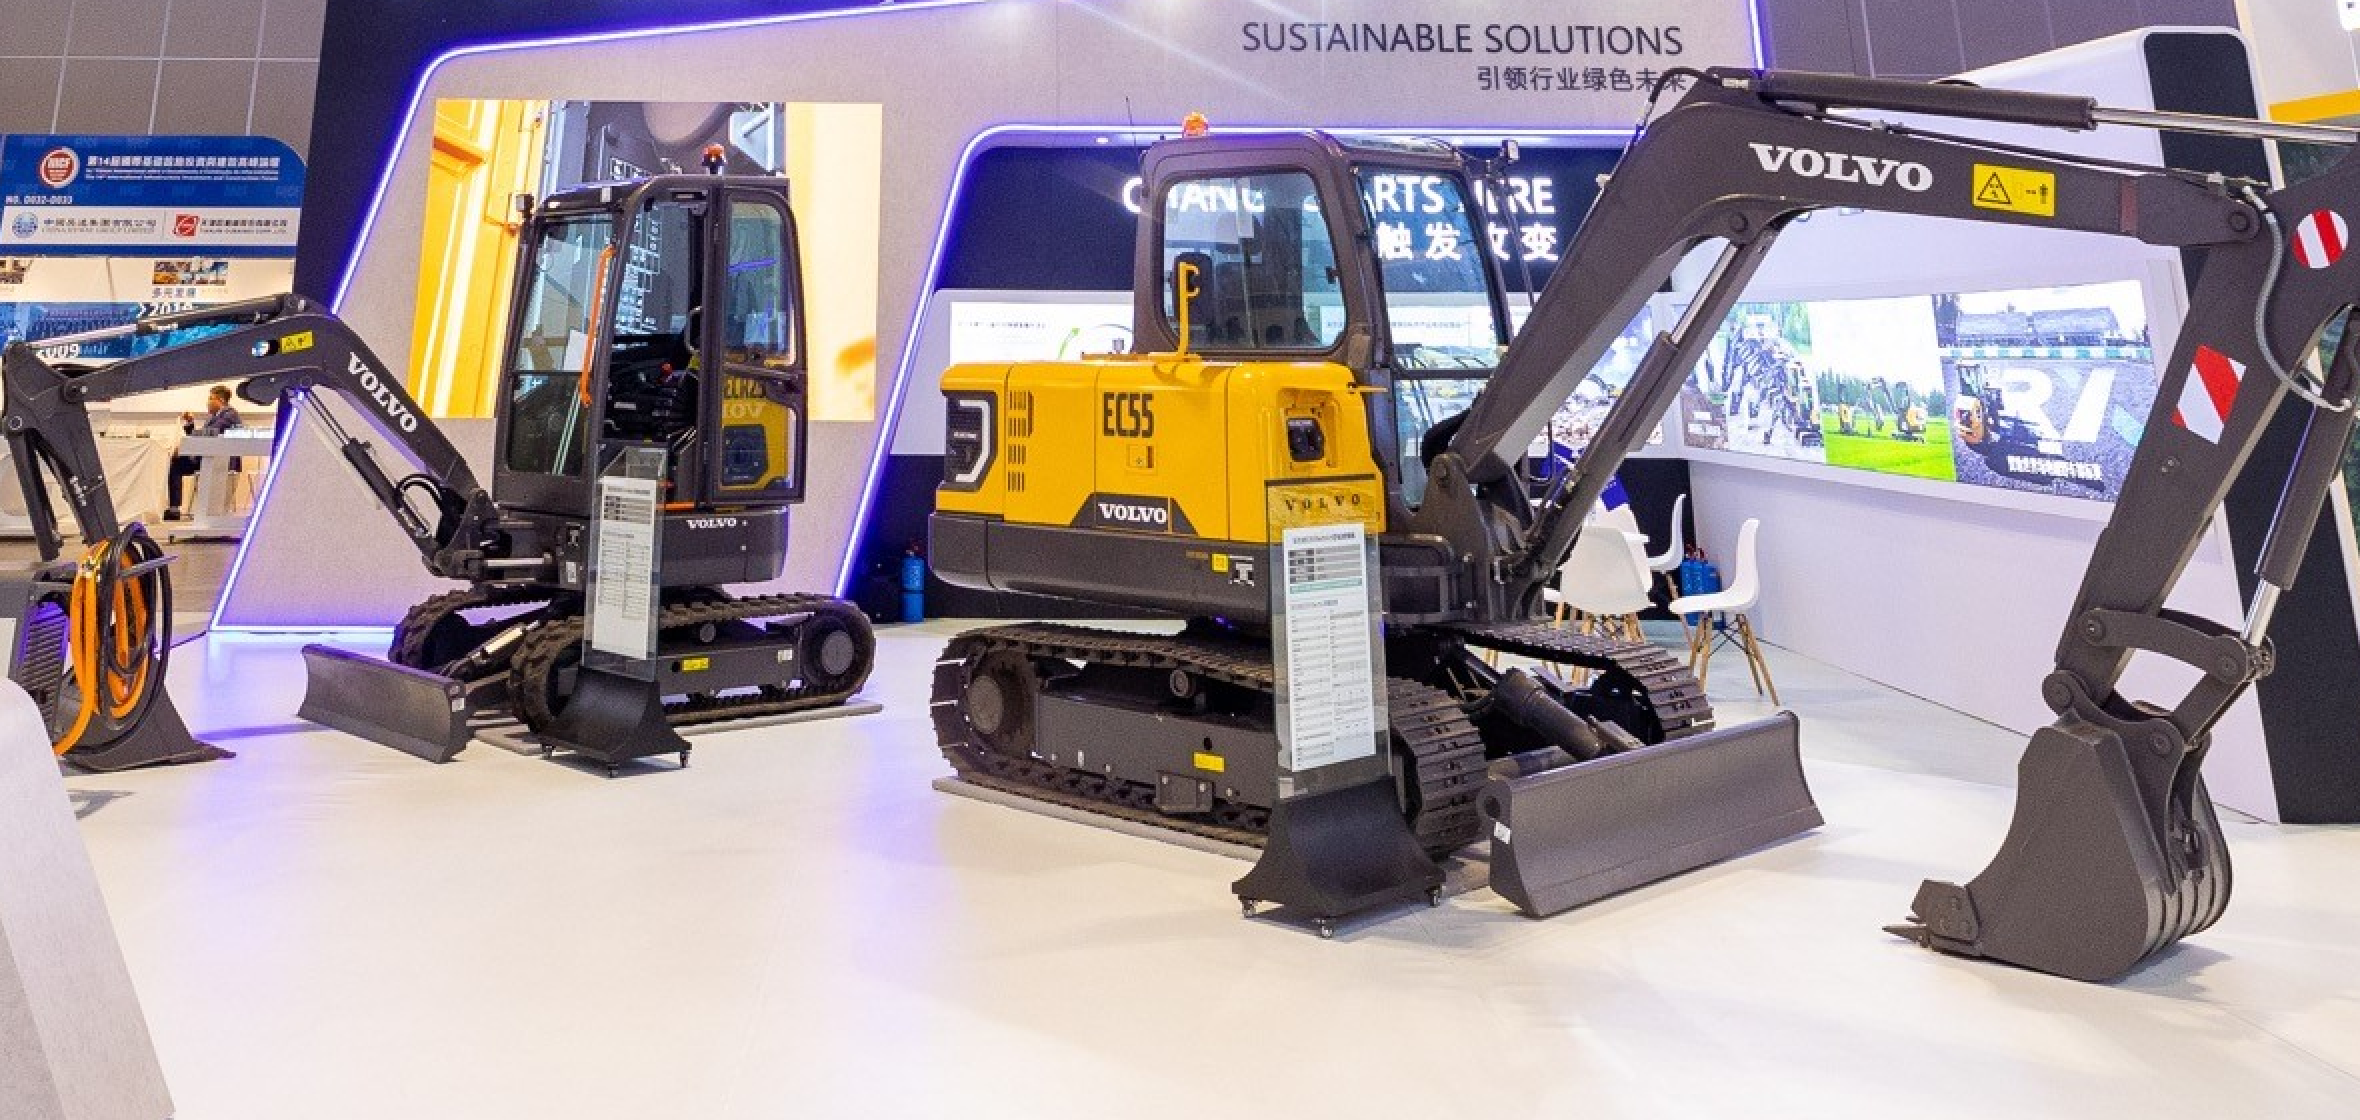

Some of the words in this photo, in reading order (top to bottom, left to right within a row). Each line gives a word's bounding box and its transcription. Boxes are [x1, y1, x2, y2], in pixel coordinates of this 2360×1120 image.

[1243, 23, 1472, 53] SUSTAINABLE
[1485, 24, 1683, 55] SOLUTIONS
[1477, 66, 1687, 92] 引领行业绿色未来
[1748, 142, 1934, 193] VOLVO
[348, 351, 418, 433] VOLVO
[1103, 391, 1154, 439] EC55
[1098, 502, 1168, 524] VOLVO
[1285, 493, 1361, 511] VOLVO
[686, 517, 737, 529] VOLVO
